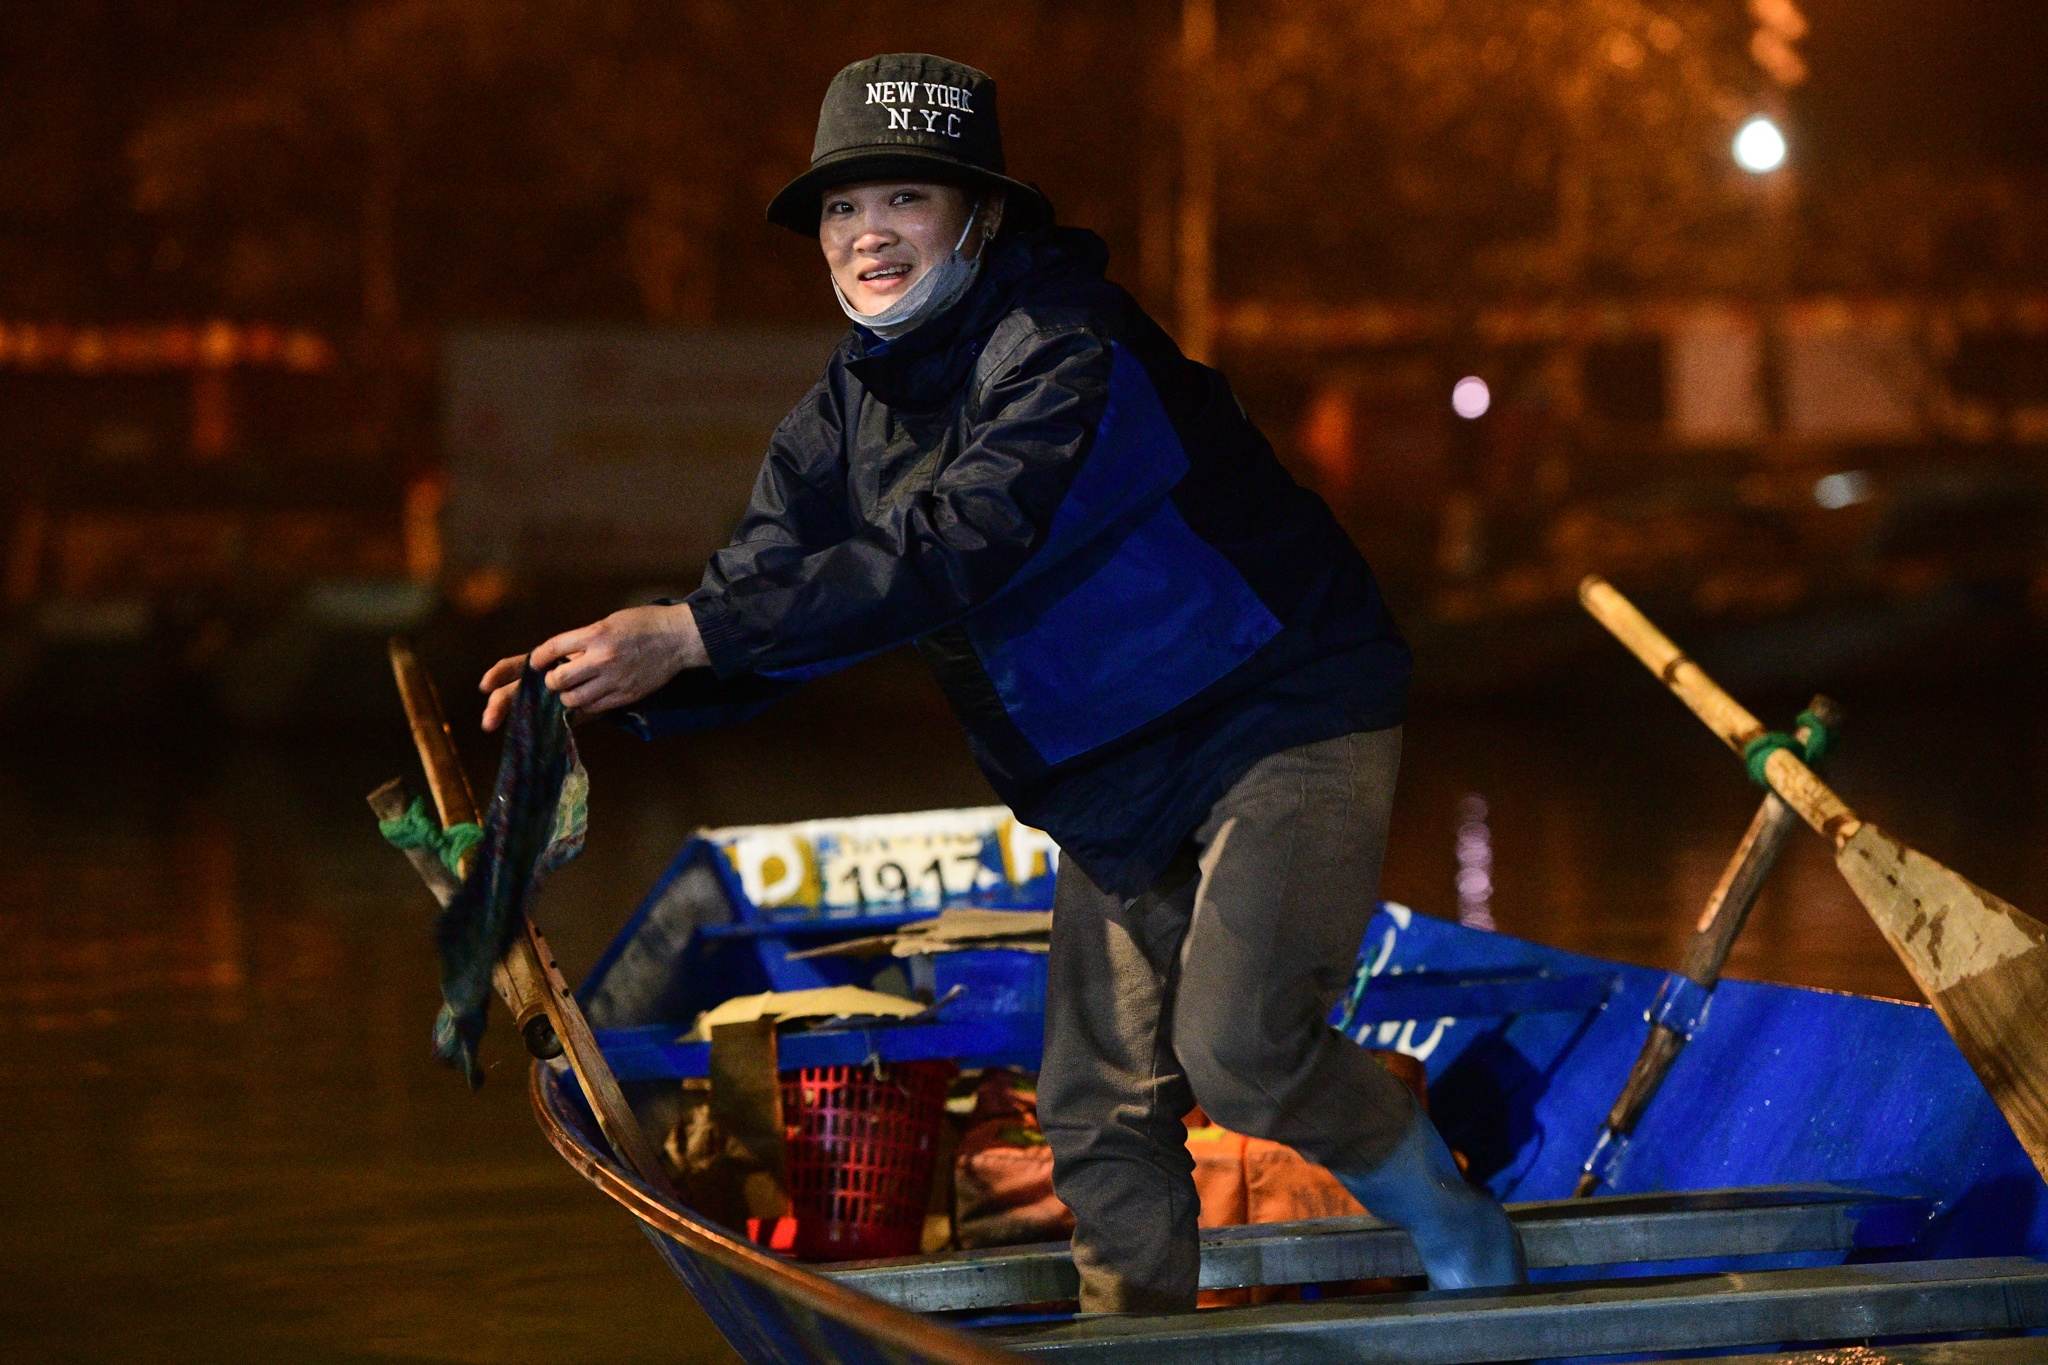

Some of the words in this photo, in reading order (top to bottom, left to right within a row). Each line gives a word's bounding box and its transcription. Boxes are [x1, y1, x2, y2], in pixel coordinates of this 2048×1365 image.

[865, 81, 918, 105] NEW
[922, 82, 974, 114] YORK
[887, 107, 961, 138] N.Y.C
[841, 857, 983, 908] 1917
